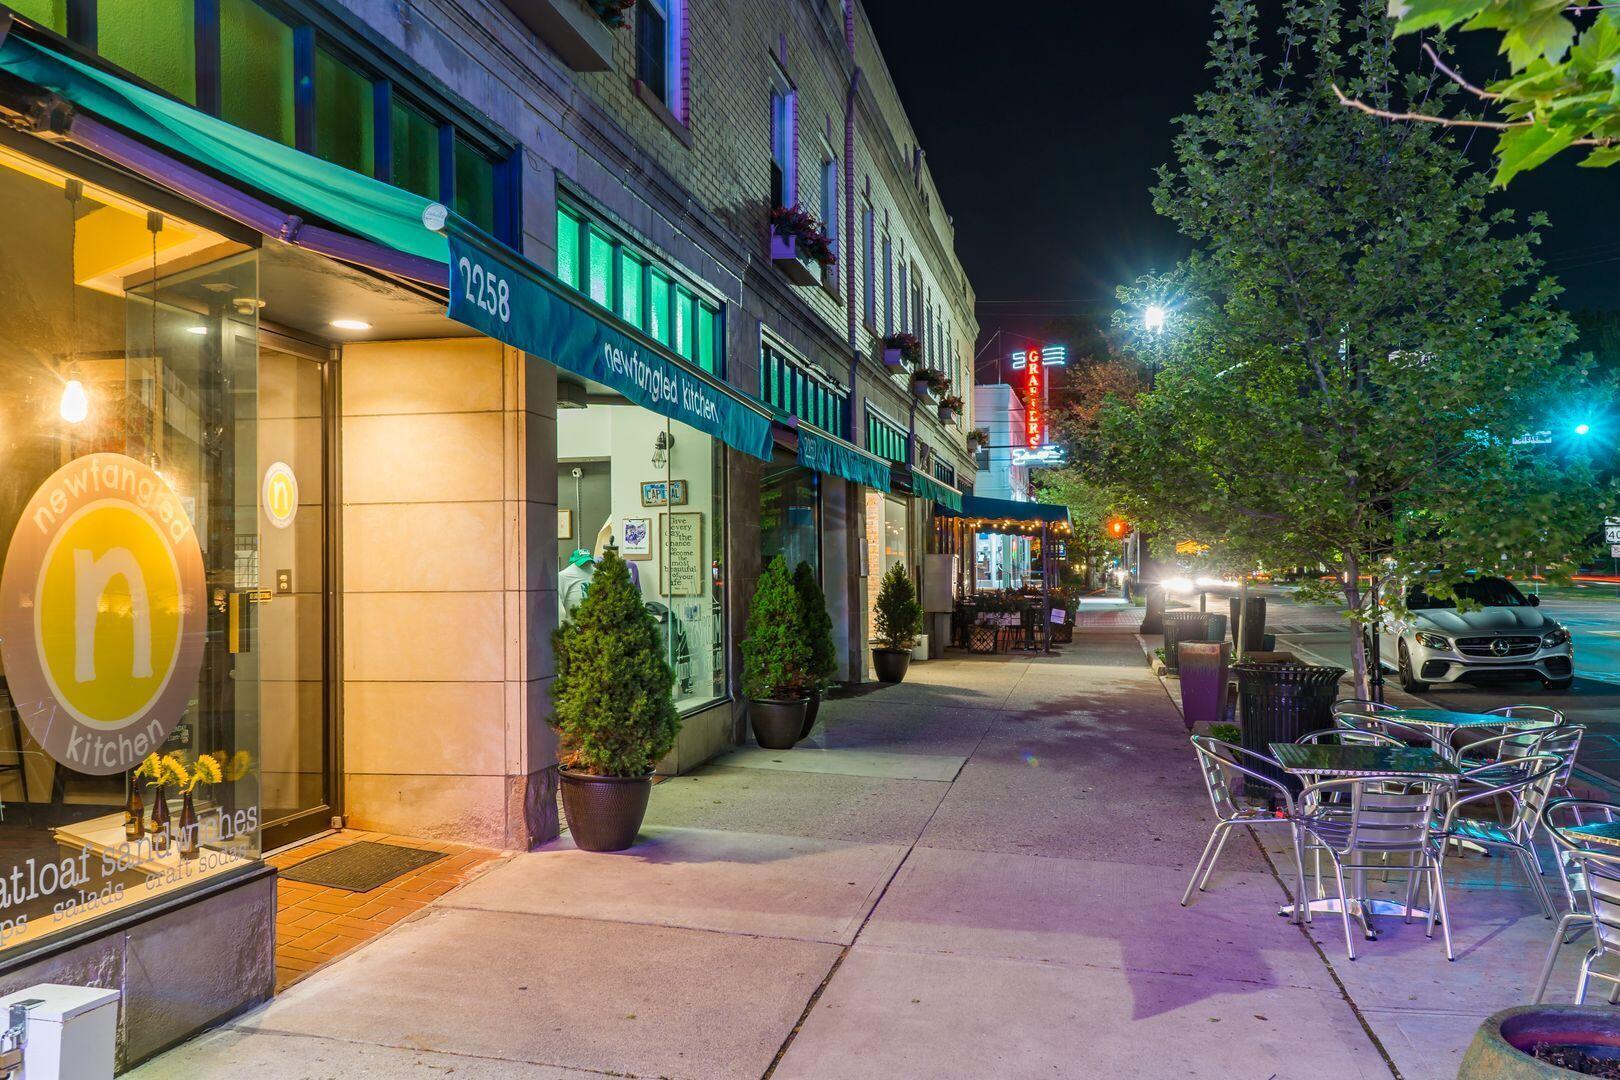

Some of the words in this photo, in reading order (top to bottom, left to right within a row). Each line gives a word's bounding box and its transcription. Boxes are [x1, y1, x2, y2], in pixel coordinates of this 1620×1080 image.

[459, 256, 511, 323] 2258
[604, 341, 679, 404] newfangled
[682, 377, 719, 424] kitchen
[32, 458, 191, 545] newfangled
[646, 487, 680, 500] CAPIAL
[679, 533, 692, 541] the
[73, 546, 154, 684] n
[65, 718, 165, 768] kitchen
[101, 805, 259, 878] sandwiches
[52, 881, 125, 923] salads
[145, 858, 193, 892] craft
[198, 844, 249, 874] sodas
